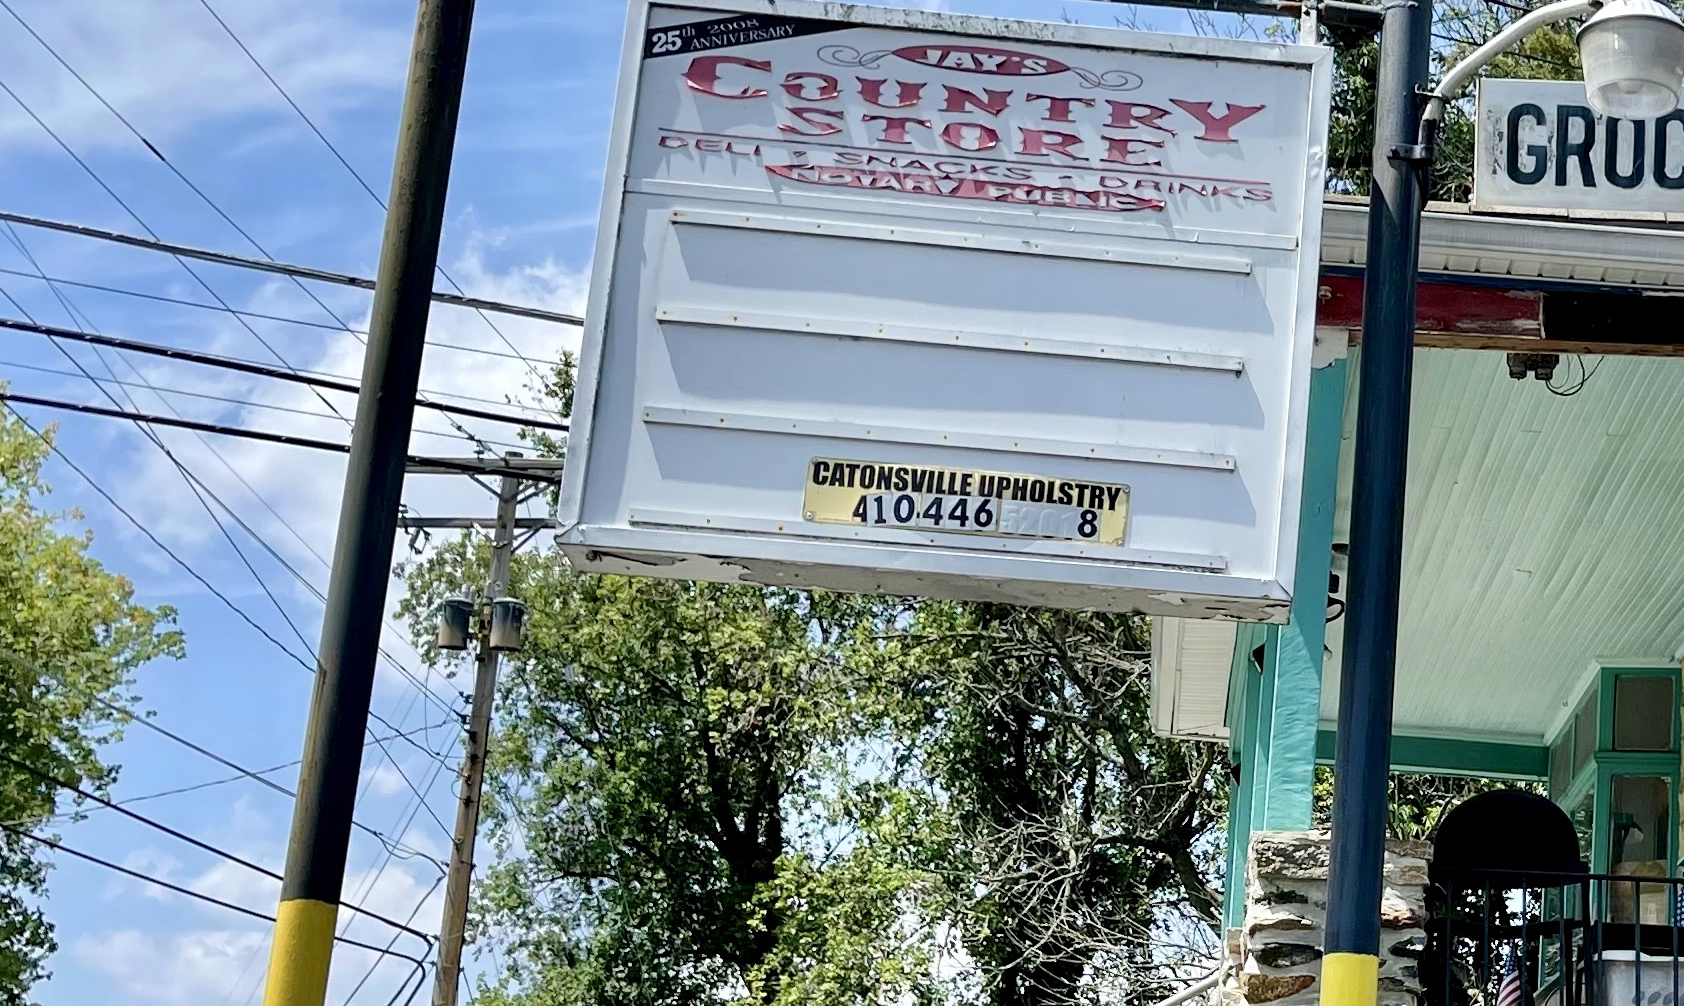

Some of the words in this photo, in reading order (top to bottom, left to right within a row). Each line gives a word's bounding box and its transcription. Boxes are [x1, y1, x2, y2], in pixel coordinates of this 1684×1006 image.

[690, 24, 796, 51] ANNIVERSARY
[707, 18, 760, 34] 2008
[915, 48, 1048, 75] JAY'S
[681, 55, 1266, 143] COUNTRY
[777, 107, 1165, 167] STORE
[658, 136, 761, 156] DELI
[833, 151, 1033, 181] SNACKS
[1099, 175, 1273, 202] DRINKS
[790, 167, 960, 195] NOTARY
[812, 460, 972, 497] CATONSVILLE
[979, 474, 1123, 511] UPHOLSTRY
